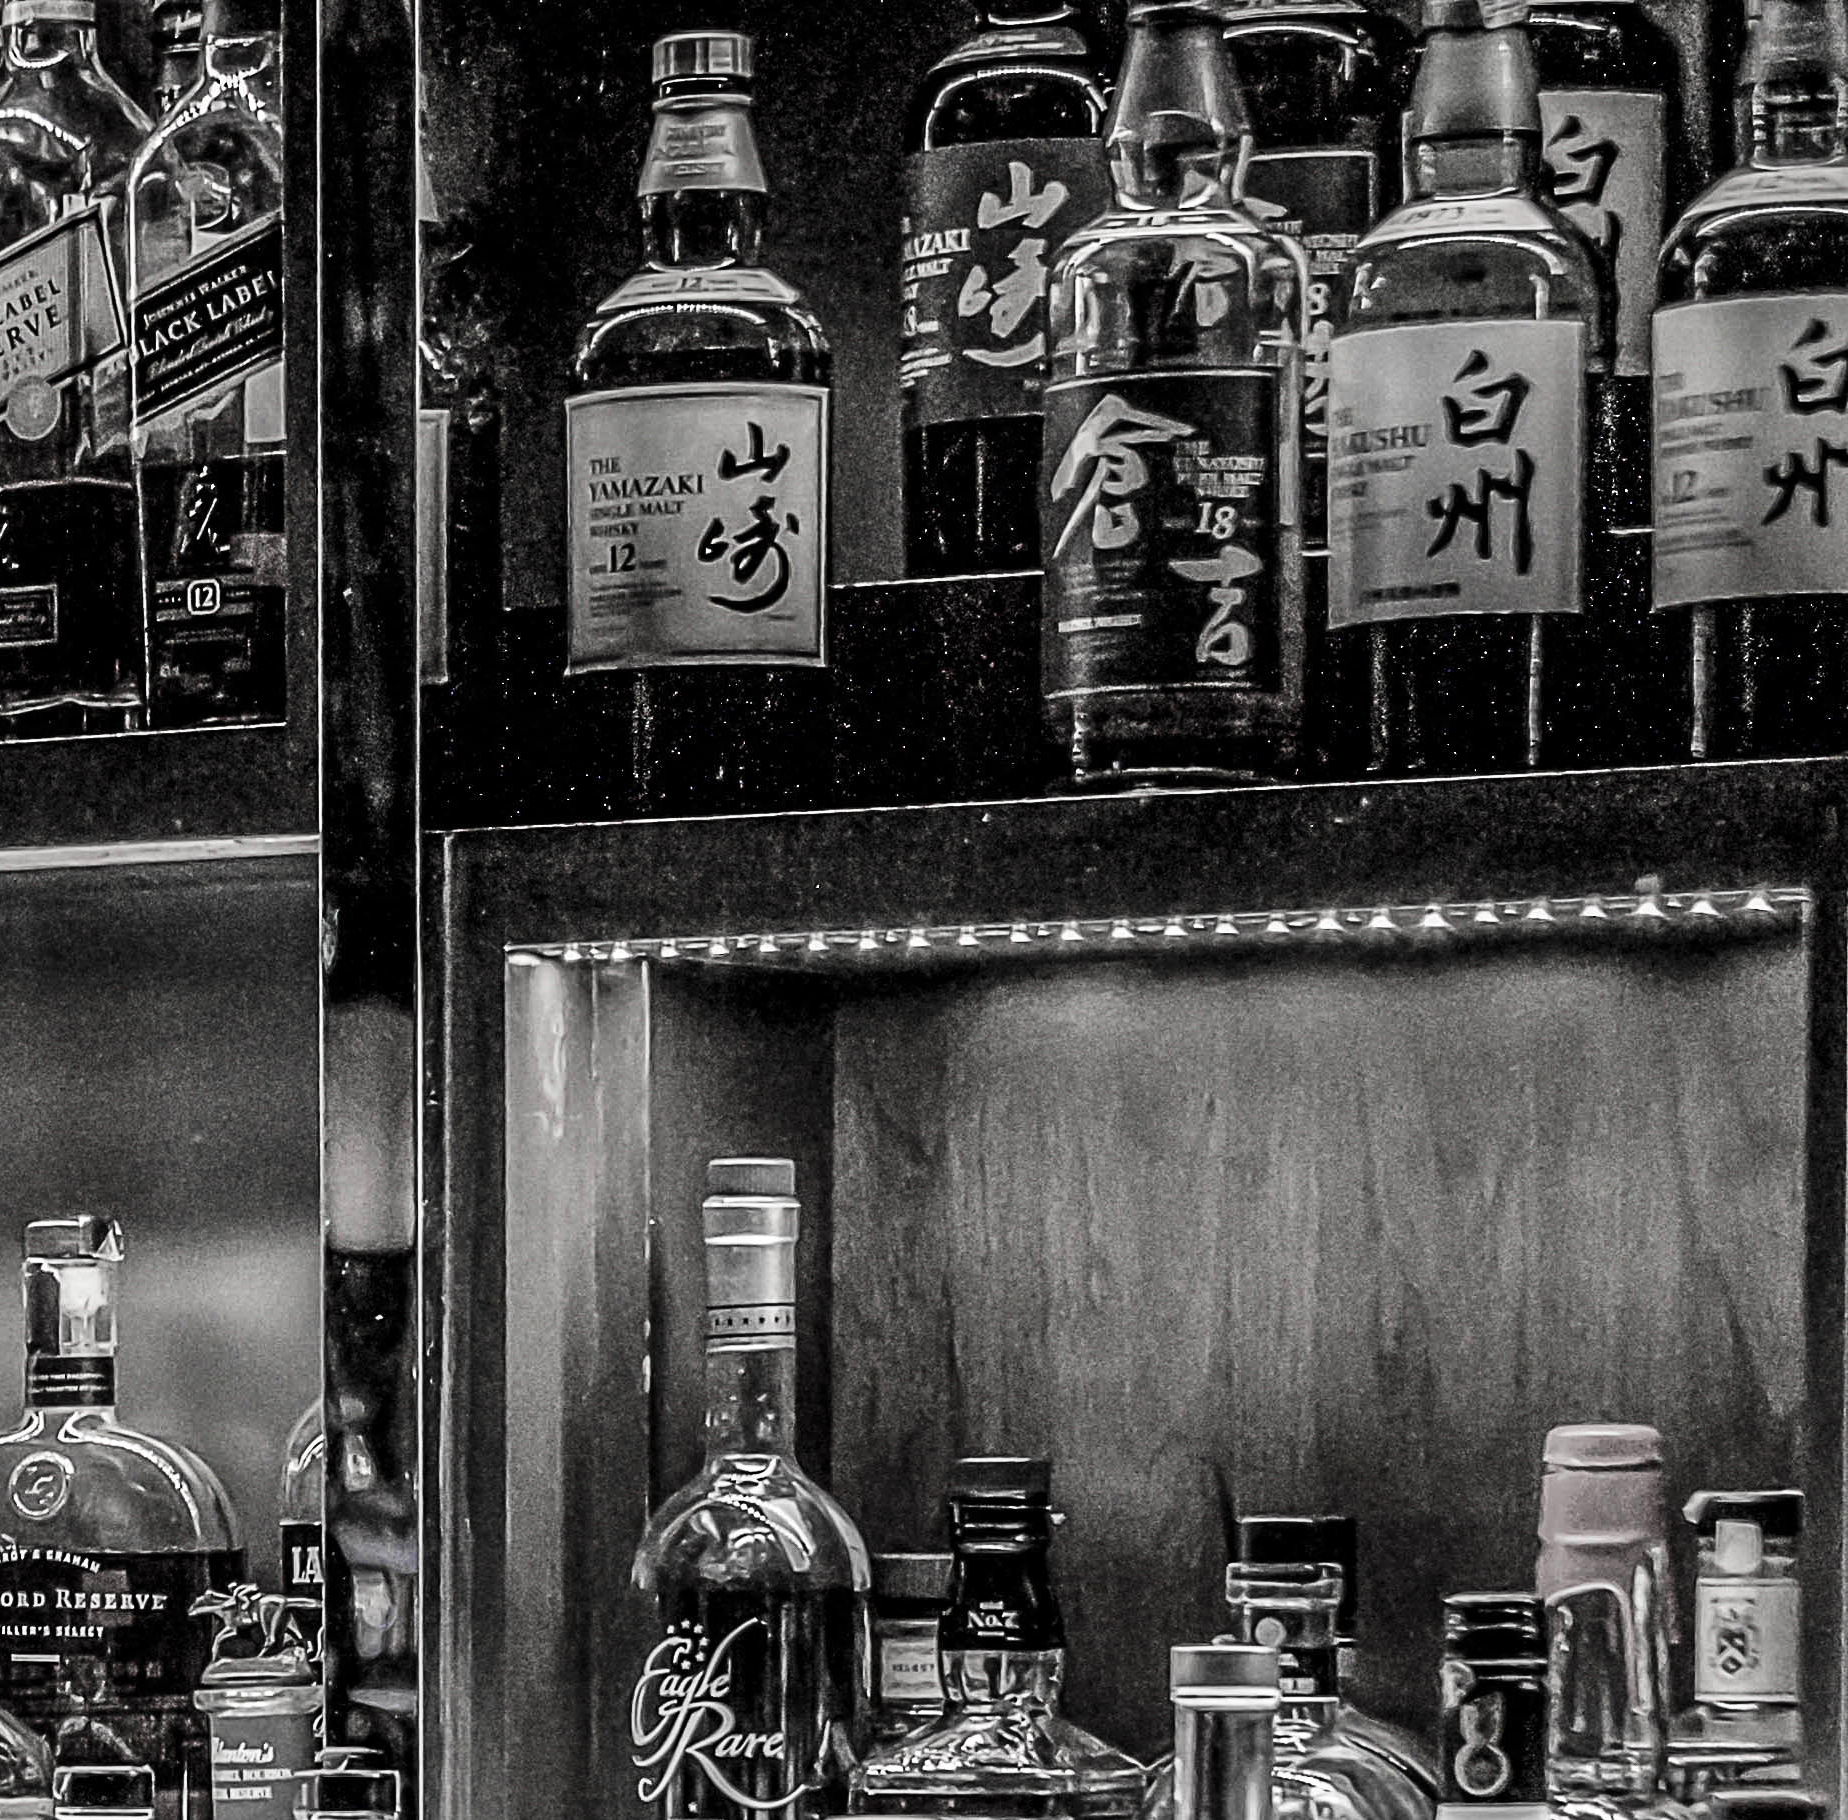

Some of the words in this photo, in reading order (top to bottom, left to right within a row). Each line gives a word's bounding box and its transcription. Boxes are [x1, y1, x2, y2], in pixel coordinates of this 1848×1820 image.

[590, 457, 621, 475] THE
[1425, 348, 1536, 576] 白州
[590, 474, 704, 503] YAMAZAKI
[638, 500, 685, 516] MALT
[697, 420, 800, 614] 山崎
[1194, 502, 1238, 540] 18
[608, 542, 637, 574] 12
[191, 586, 216, 608] 12
[45, 1549, 103, 1575] GRAHAM
[291, 1546, 325, 1585] LA
[55, 1587, 169, 1611] RESERVE
